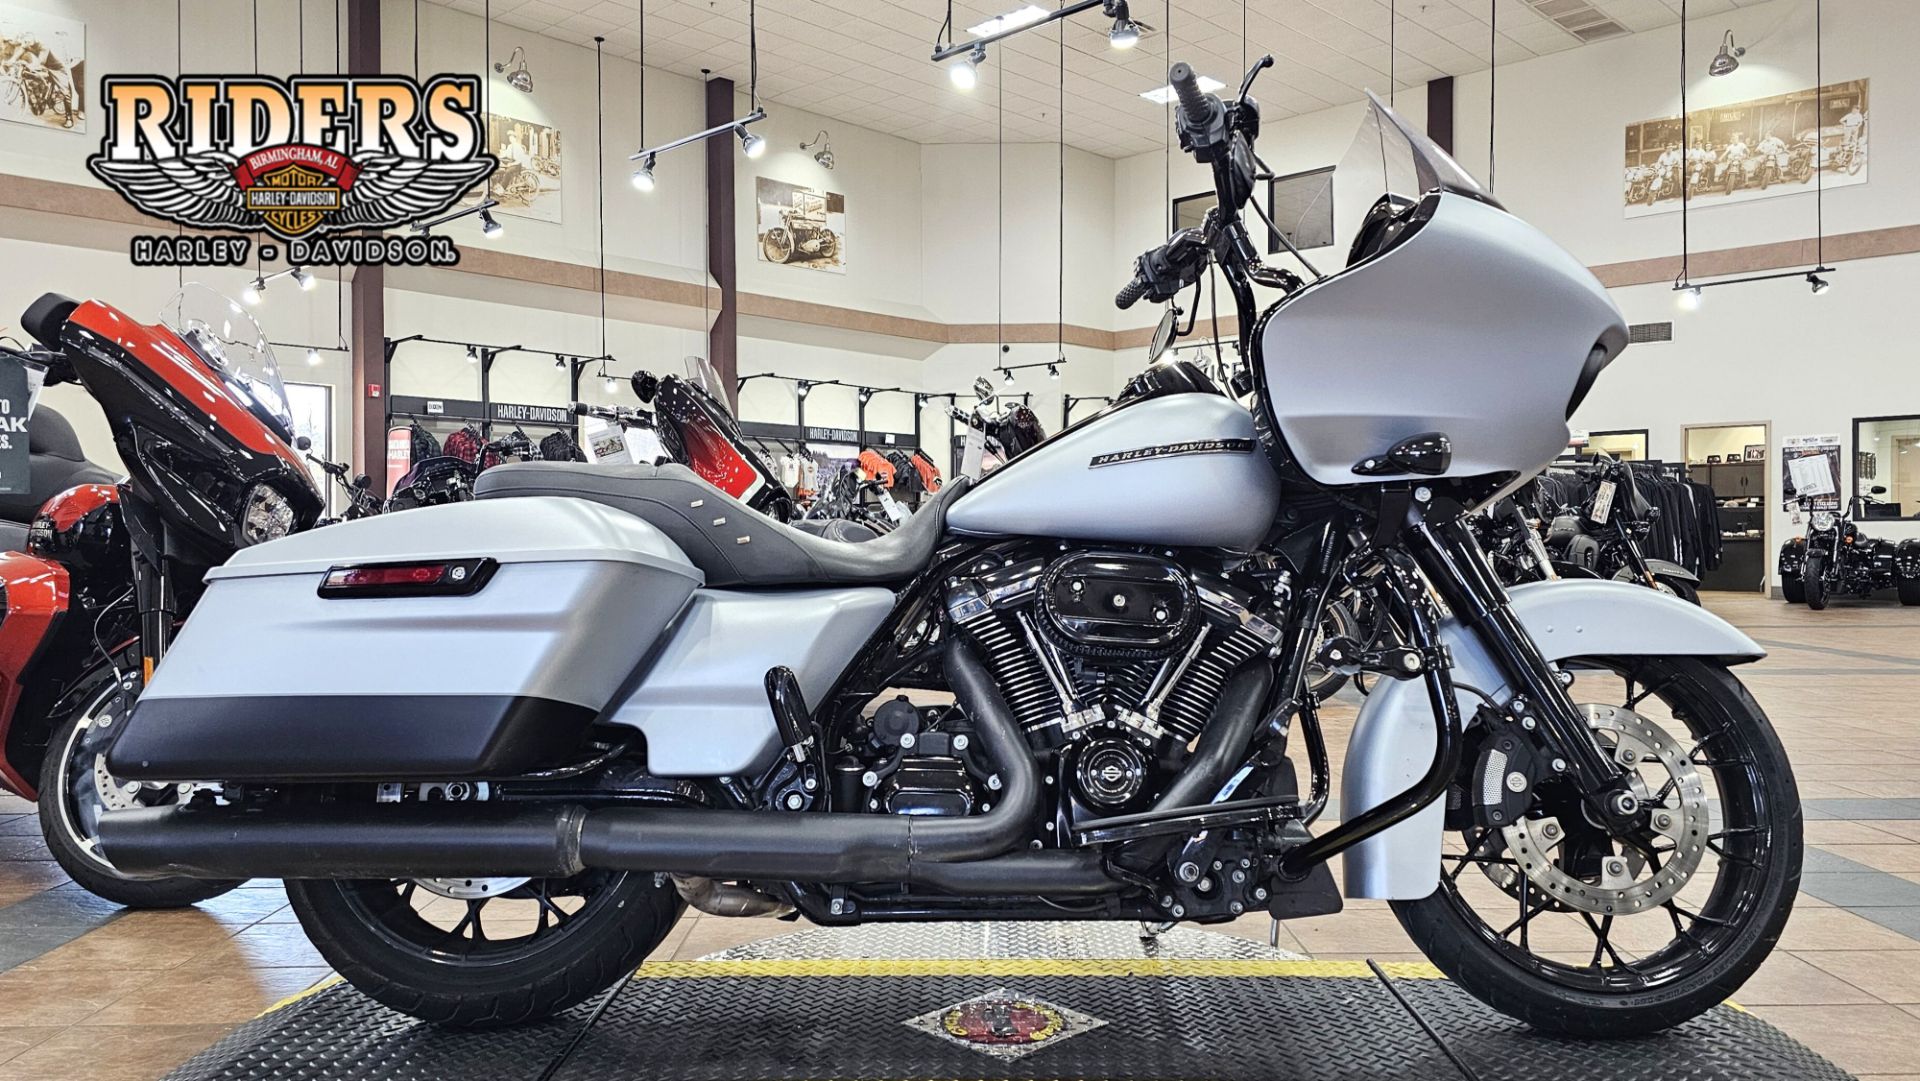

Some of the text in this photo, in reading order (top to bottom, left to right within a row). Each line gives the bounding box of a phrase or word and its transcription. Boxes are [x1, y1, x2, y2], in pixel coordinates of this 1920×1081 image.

[0, 398, 10, 415] O
[497, 405, 568, 423] HARLEY-DAVIDSON
[809, 428, 858, 442] HARLEY-DAVIDSON
[1097, 441, 1252, 464] HARLEY-DAVIDSON
